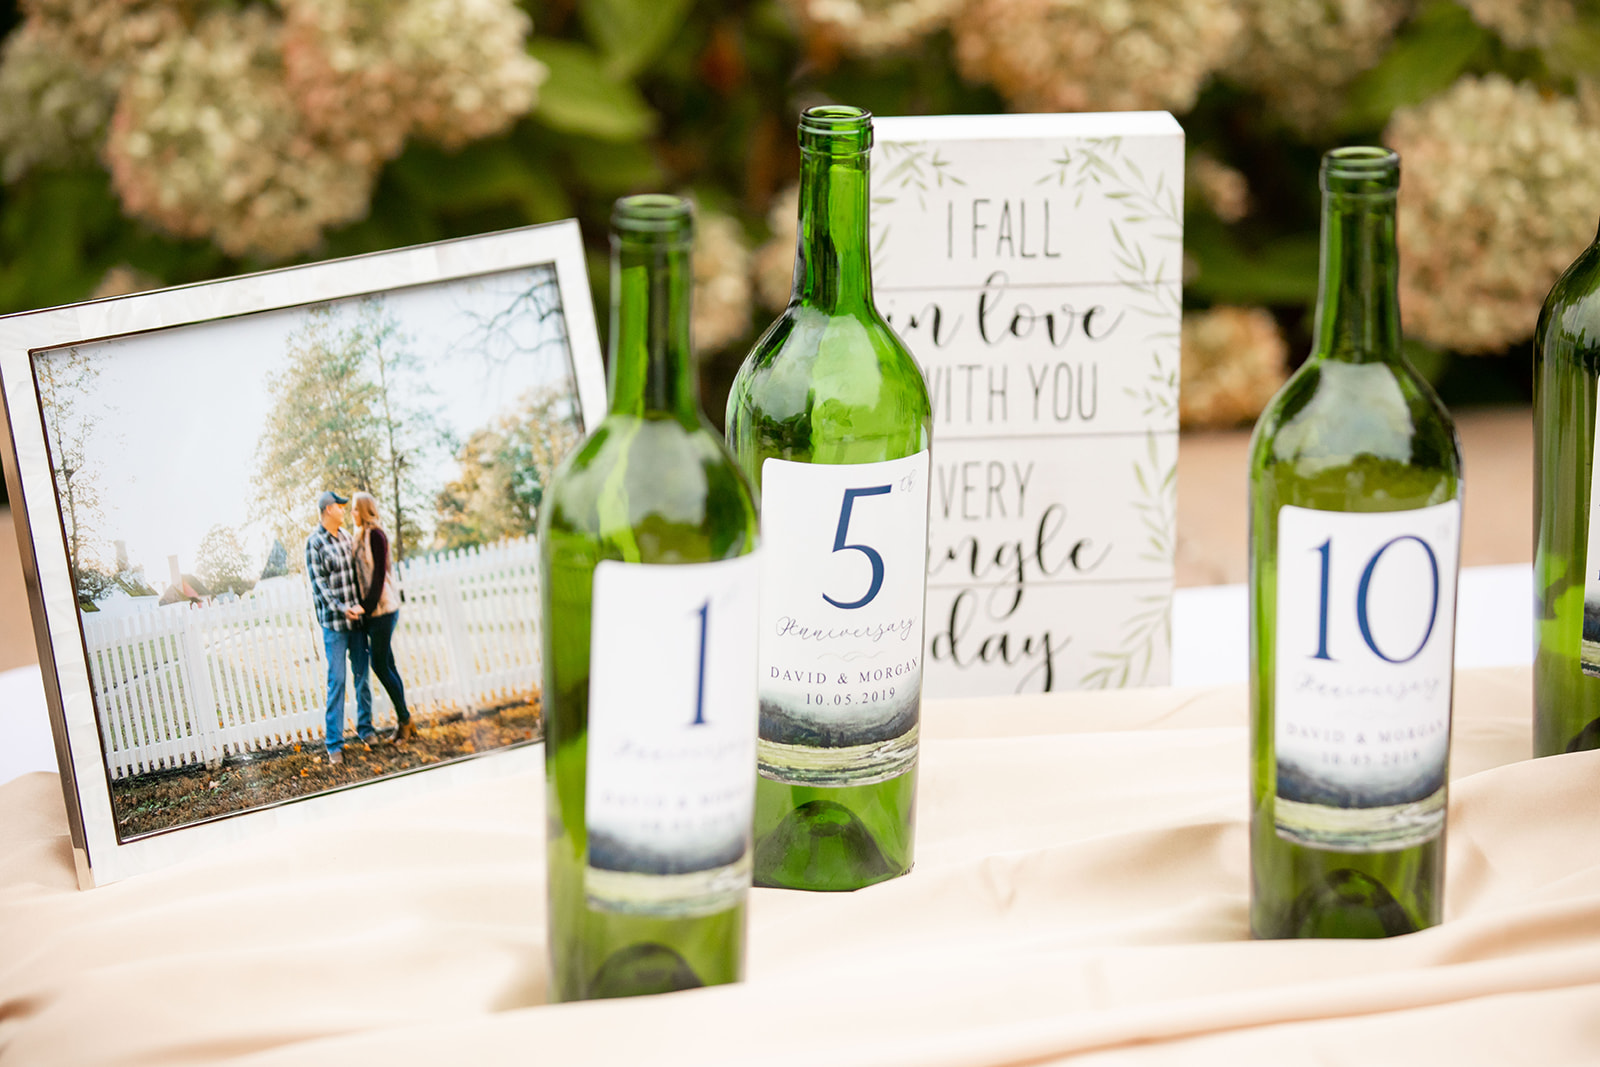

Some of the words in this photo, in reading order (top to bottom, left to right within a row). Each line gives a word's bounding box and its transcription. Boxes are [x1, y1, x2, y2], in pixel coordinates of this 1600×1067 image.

[946, 199, 954, 259] I
[971, 198, 1061, 260] FALL
[977, 270, 1126, 349] love
[1027, 361, 1098, 423] YOU
[937, 460, 1035, 520] VERY
[822, 483, 893, 610] 5
[927, 503, 1113, 622] ngle
[775, 615, 917, 642] Anniversary
[1306, 534, 1440, 665] 10
[685, 595, 714, 730] 1
[770, 666, 827, 685] DAVID
[837, 672, 848, 685] &
[859, 656, 918, 684] MORGAN
[931, 588, 1072, 695] day
[806, 687, 896, 706] 10.05.2019
